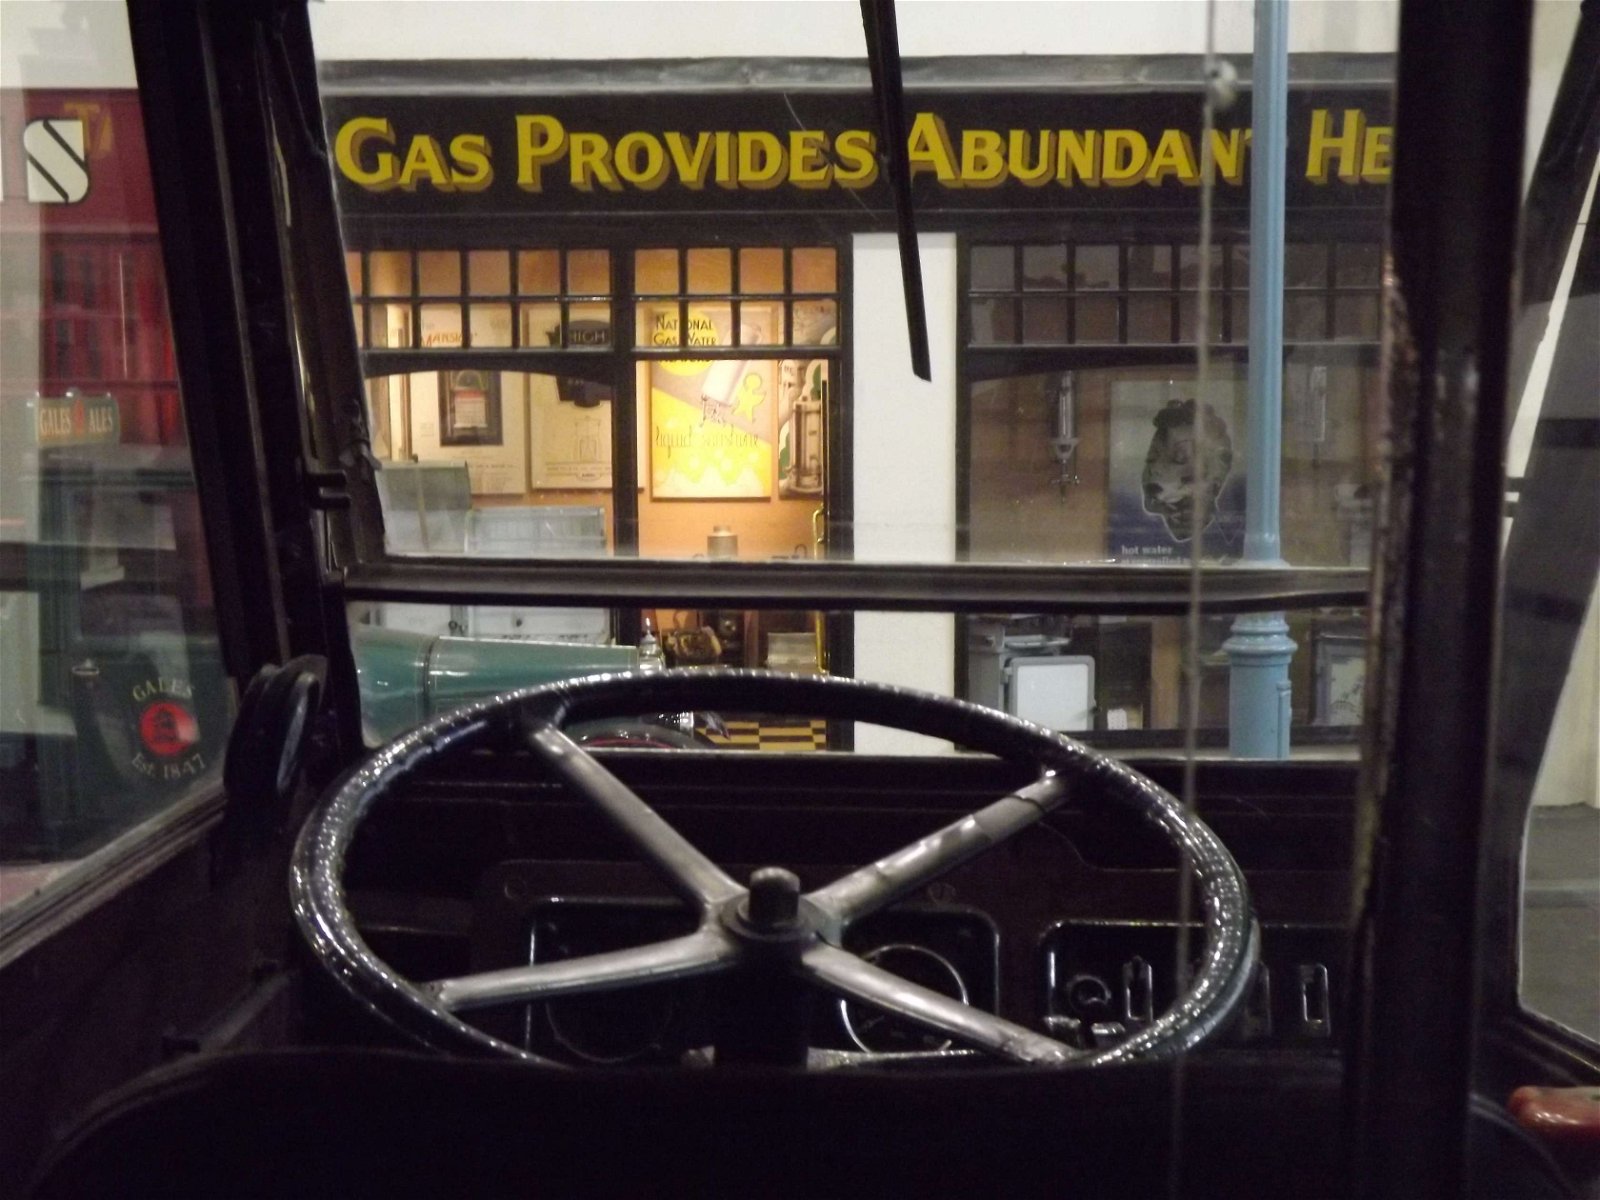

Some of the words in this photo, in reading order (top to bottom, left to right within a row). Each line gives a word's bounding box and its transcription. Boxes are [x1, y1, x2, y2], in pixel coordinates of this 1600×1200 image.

[335, 116, 494, 193] GAS
[515, 114, 878, 193] PROVIDES
[908, 112, 1253, 189] ABUNDAN
[656, 313, 713, 331] NATONAL
[1121, 544, 1139, 556] hot
[1142, 544, 1173, 556] water
